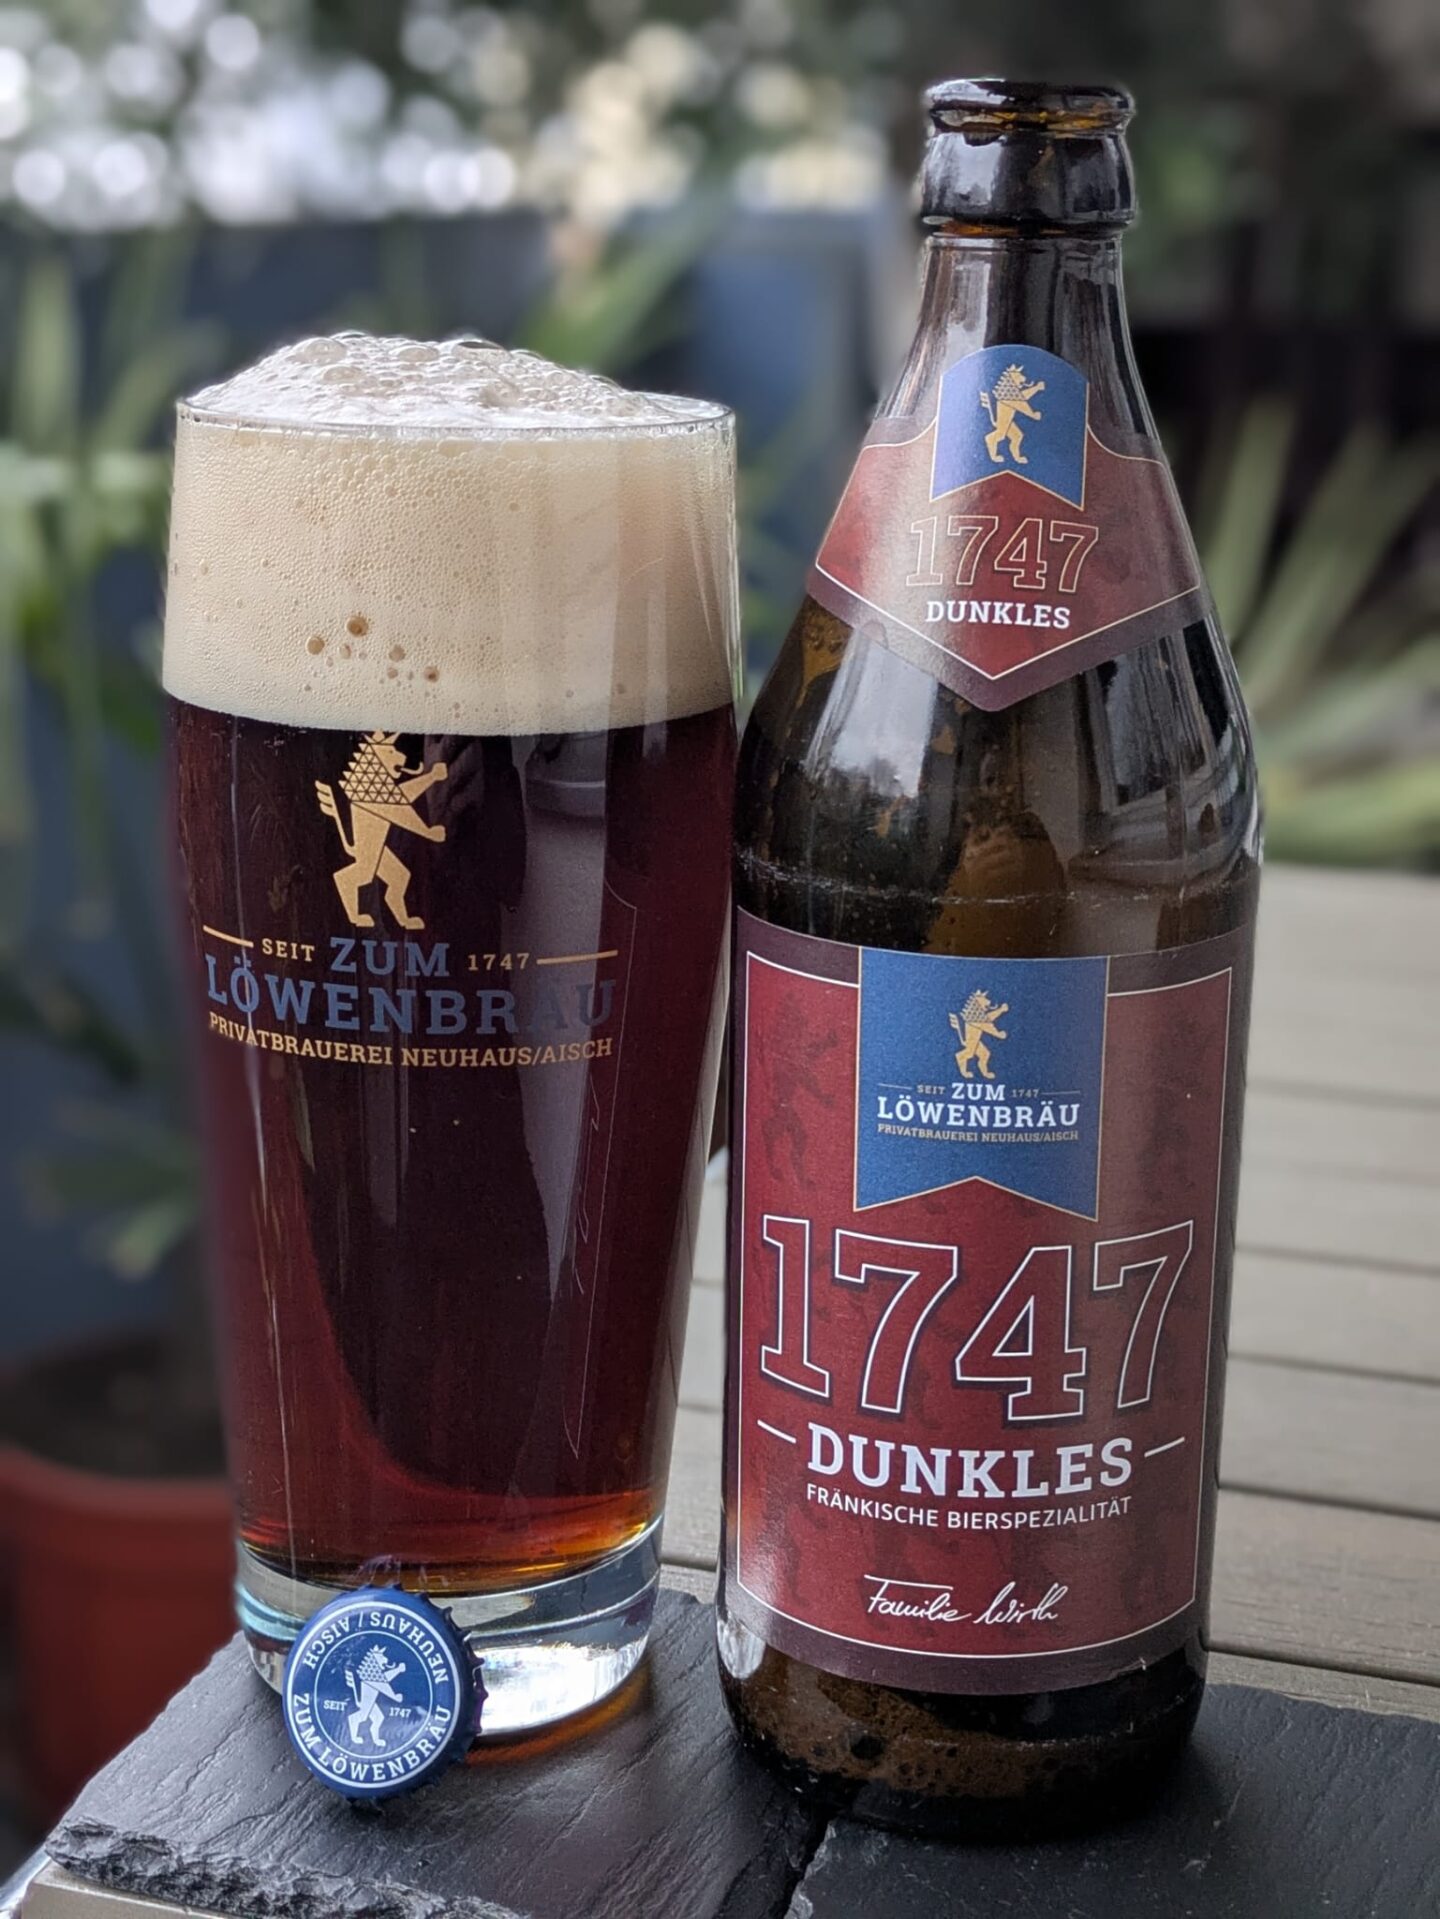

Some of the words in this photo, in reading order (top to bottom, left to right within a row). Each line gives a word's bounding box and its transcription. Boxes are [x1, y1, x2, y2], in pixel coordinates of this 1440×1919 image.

[906, 515, 1099, 593] 1747
[926, 600, 1071, 629] DUNKLES
[262, 938, 316, 962] SEIT
[330, 936, 450, 977] ZUM
[468, 953, 531, 972] 1747
[209, 1011, 393, 1066] PRIVATBRAUEREI
[402, 1037, 613, 1068] NEUHAUS/AISCH
[877, 1094, 1080, 1128] LÖWENBRÄU
[917, 1084, 946, 1095] SEIT
[951, 1082, 1006, 1101] ZUM
[1011, 1088, 1040, 1098] 1747
[877, 1123, 978, 1142] PRIVATBRAUEREI
[981, 1130, 1079, 1143] NEUHAUS/AISCH
[761, 1214, 1194, 1421] 1747
[808, 1421, 1133, 1498] DUNKLES
[806, 1483, 938, 1527] FRÄNKISCHE
[947, 1495, 1132, 1530] BIERSPEZIALITÄT
[864, 1574, 970, 1622] Familie
[303, 1616, 350, 1670] AISCH
[370, 1611, 449, 1684] NEUHAUS
[323, 1700, 347, 1711] SEIT
[389, 1707, 411, 1717] 1747
[294, 1693, 320, 1750] ZUM
[318, 1705, 451, 1782] LÖWENBRÄU
